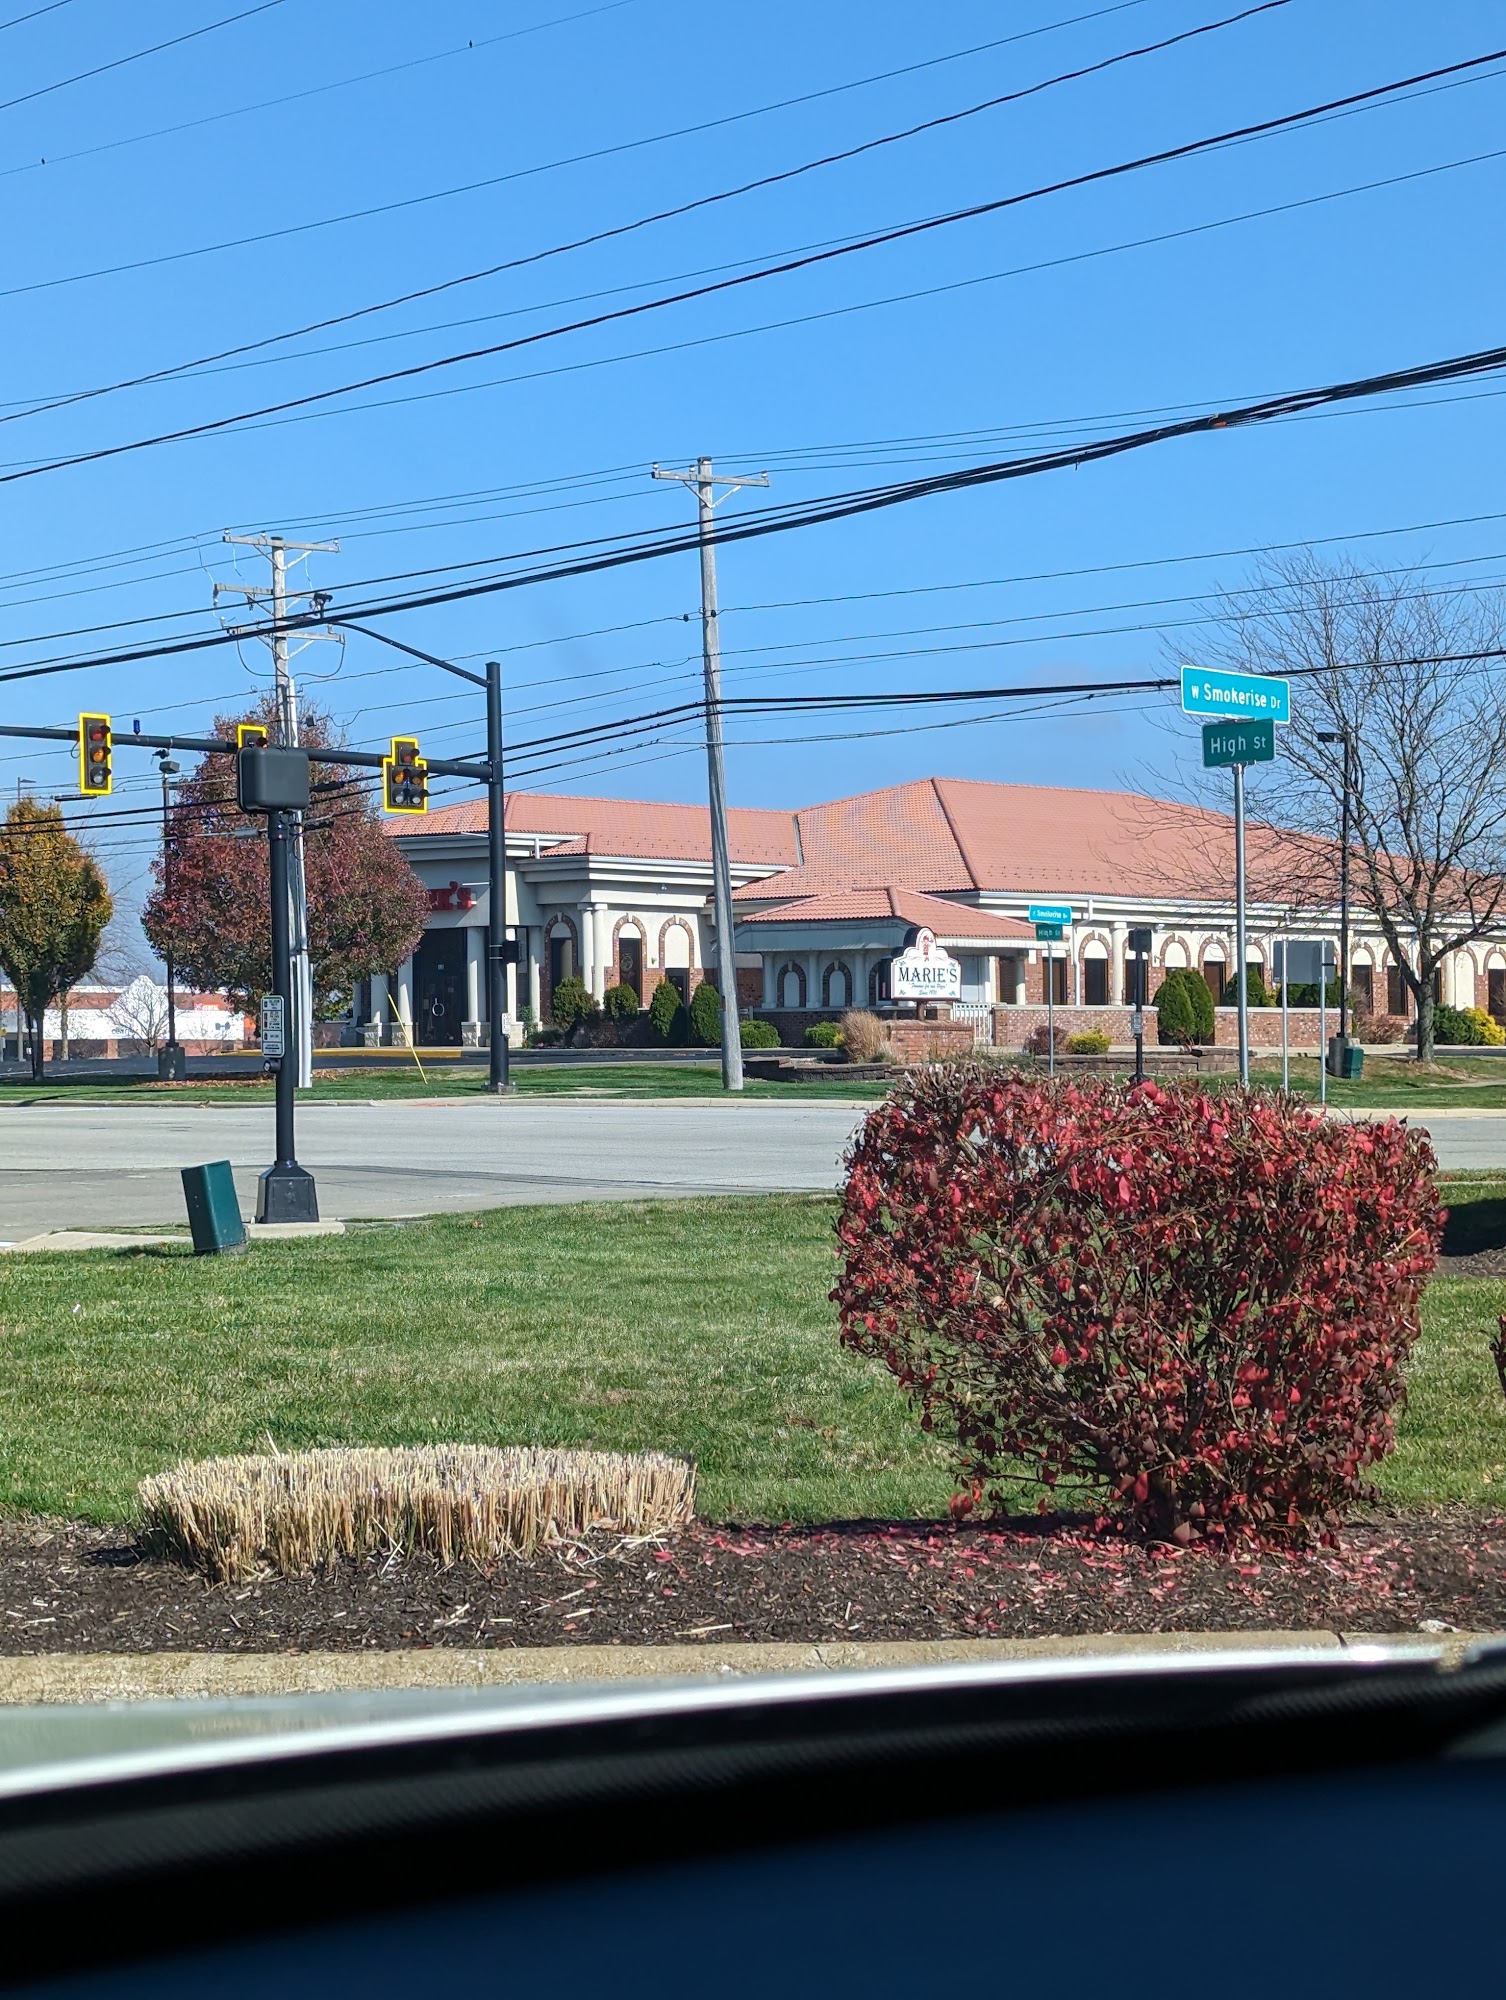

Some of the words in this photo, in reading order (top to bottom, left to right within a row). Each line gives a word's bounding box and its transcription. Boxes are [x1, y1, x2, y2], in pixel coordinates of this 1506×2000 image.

[1191, 685, 1199, 699] W
[1203, 683, 1267, 707] Smokerise
[1270, 695, 1281, 709] Dr
[1210, 736, 1246, 757] High
[1253, 736, 1266, 749] St
[898, 967, 957, 983] MARIE'S
